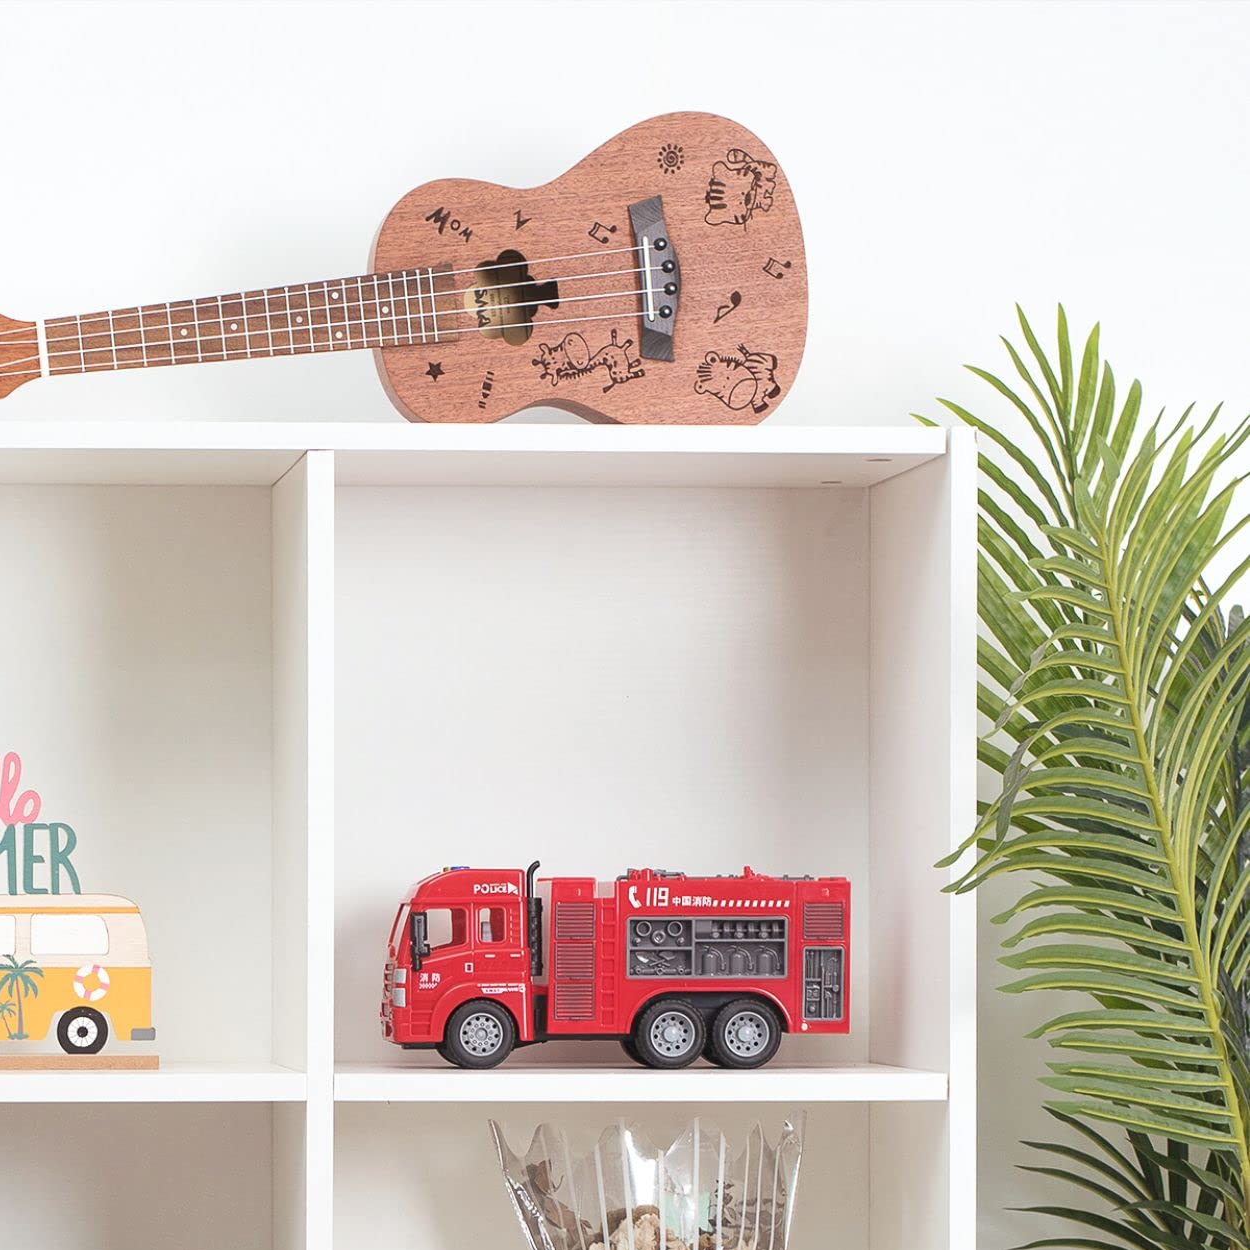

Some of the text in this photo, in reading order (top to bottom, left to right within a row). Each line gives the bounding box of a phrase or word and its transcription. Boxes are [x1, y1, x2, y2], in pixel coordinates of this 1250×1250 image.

[646, 887, 712, 907] 119 中国消防
